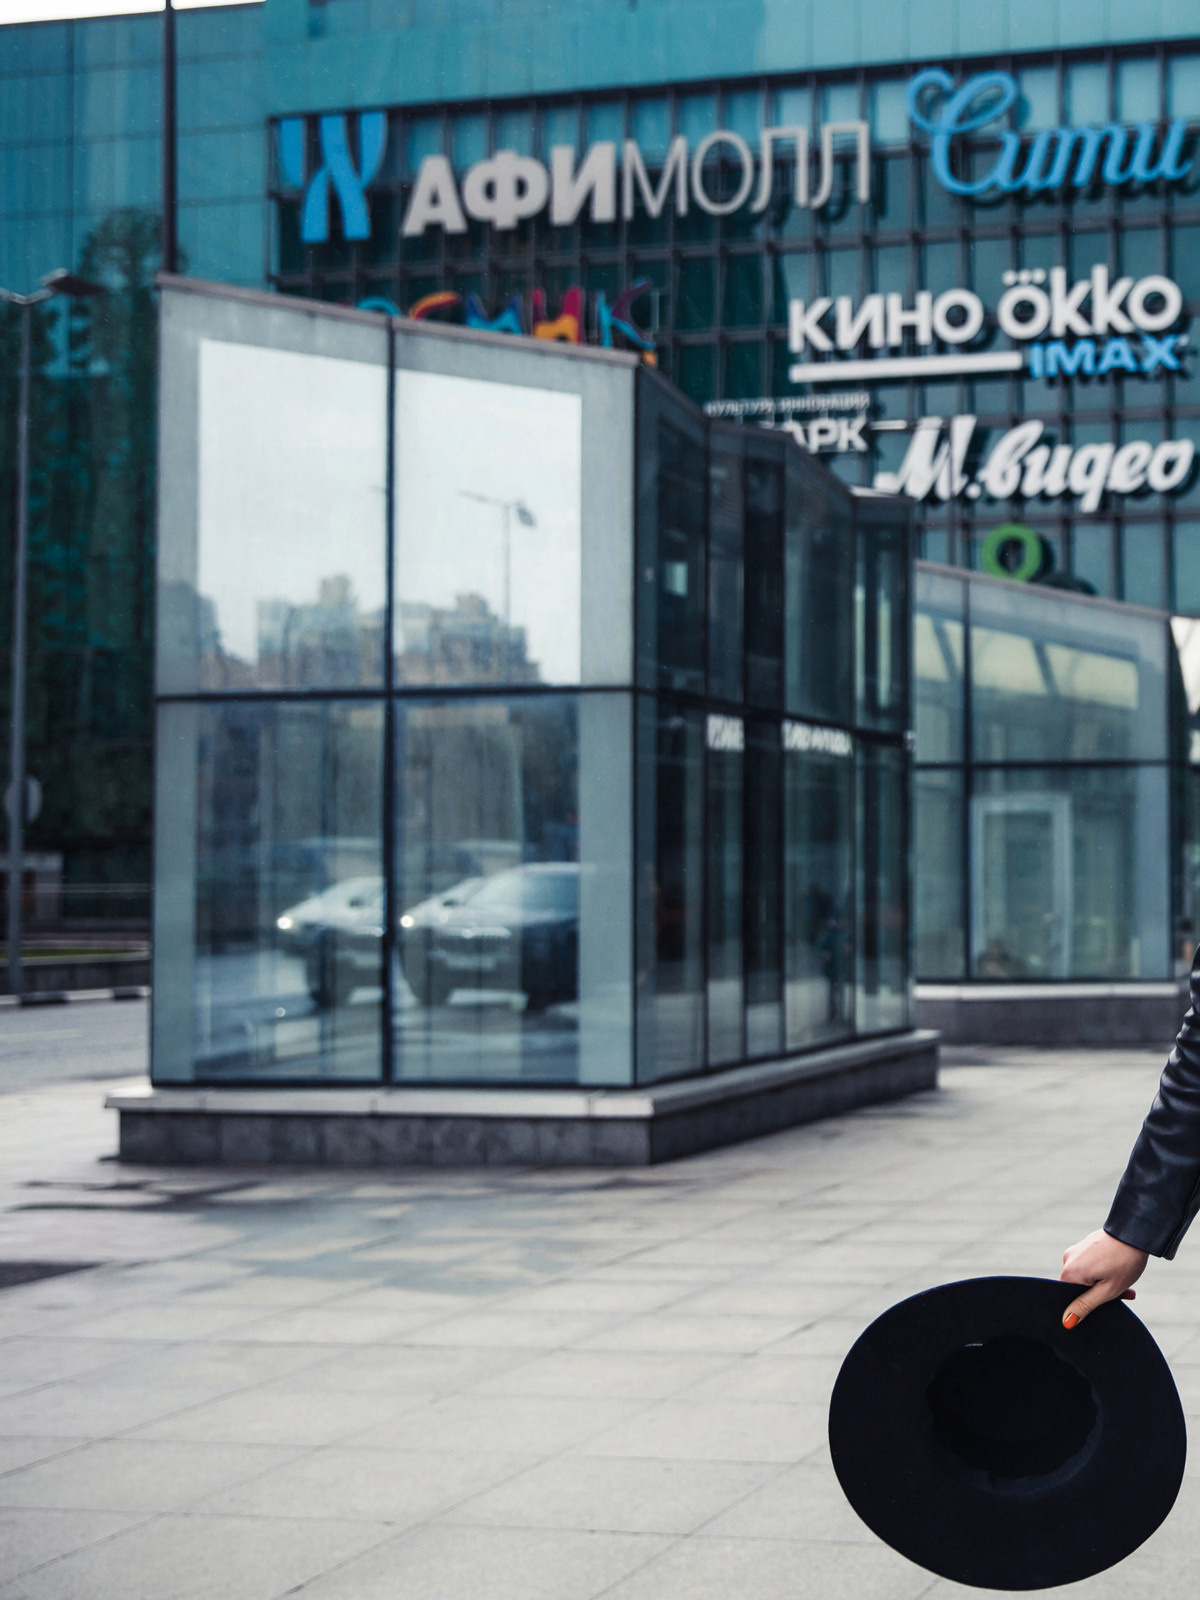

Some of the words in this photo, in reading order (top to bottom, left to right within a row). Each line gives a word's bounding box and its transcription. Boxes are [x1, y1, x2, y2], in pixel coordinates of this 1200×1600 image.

[403, 120, 870, 238] АФИМОЛЛ
[905, 66, 1194, 195] Сити
[789, 288, 985, 354] КИНО
[1029, 334, 1184, 378] IMAX
[874, 414, 1195, 513] М.видео
